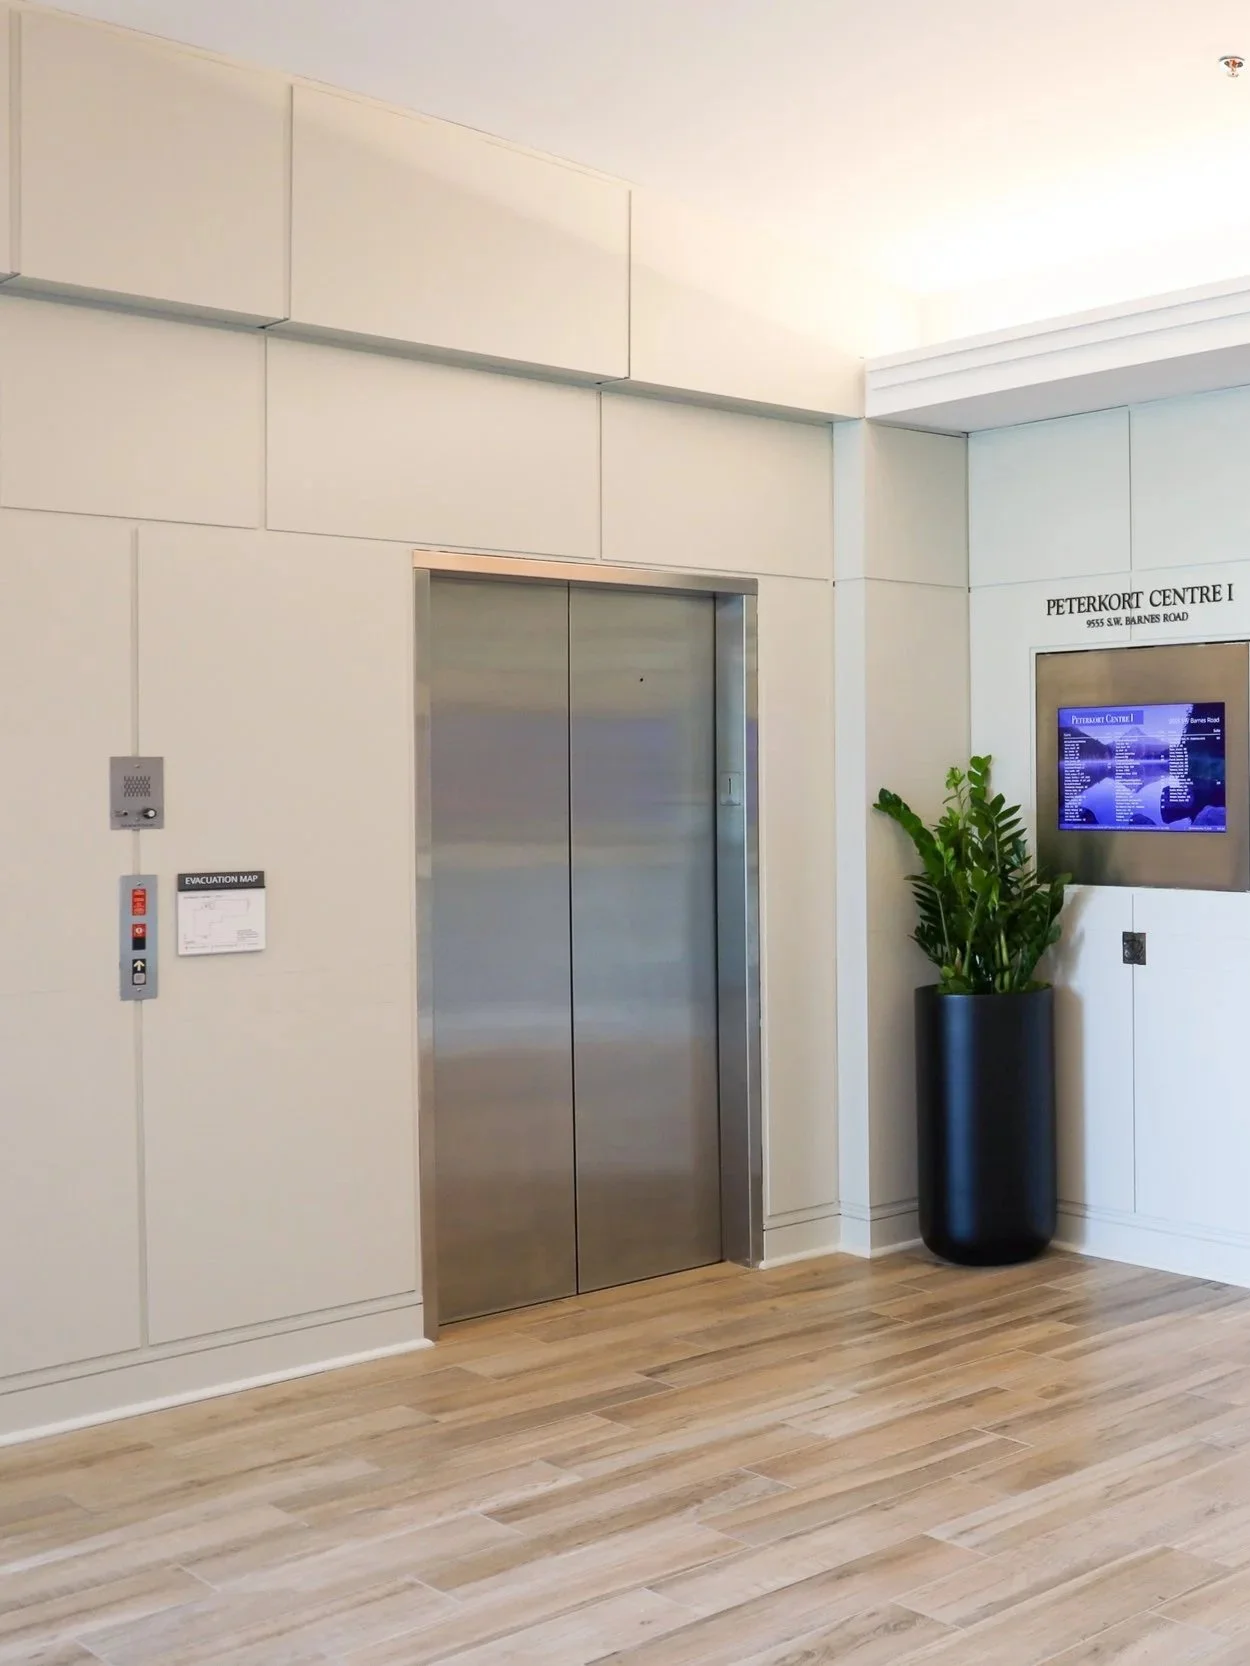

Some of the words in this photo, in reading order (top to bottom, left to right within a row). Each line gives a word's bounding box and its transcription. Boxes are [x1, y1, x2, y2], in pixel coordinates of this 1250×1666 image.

[1046, 591, 1144, 616] PETERKORT
[1149, 584, 1223, 608] CENTRE
[1227, 583, 1234, 602] I
[1086, 617, 1104, 628] 9555
[1107, 617, 1123, 627] S.W.
[1125, 614, 1161, 626] BARNES
[1163, 612, 1189, 623] ROAD
[185, 875, 238, 885] EVACUATION
[239, 874, 258, 883] MAP
